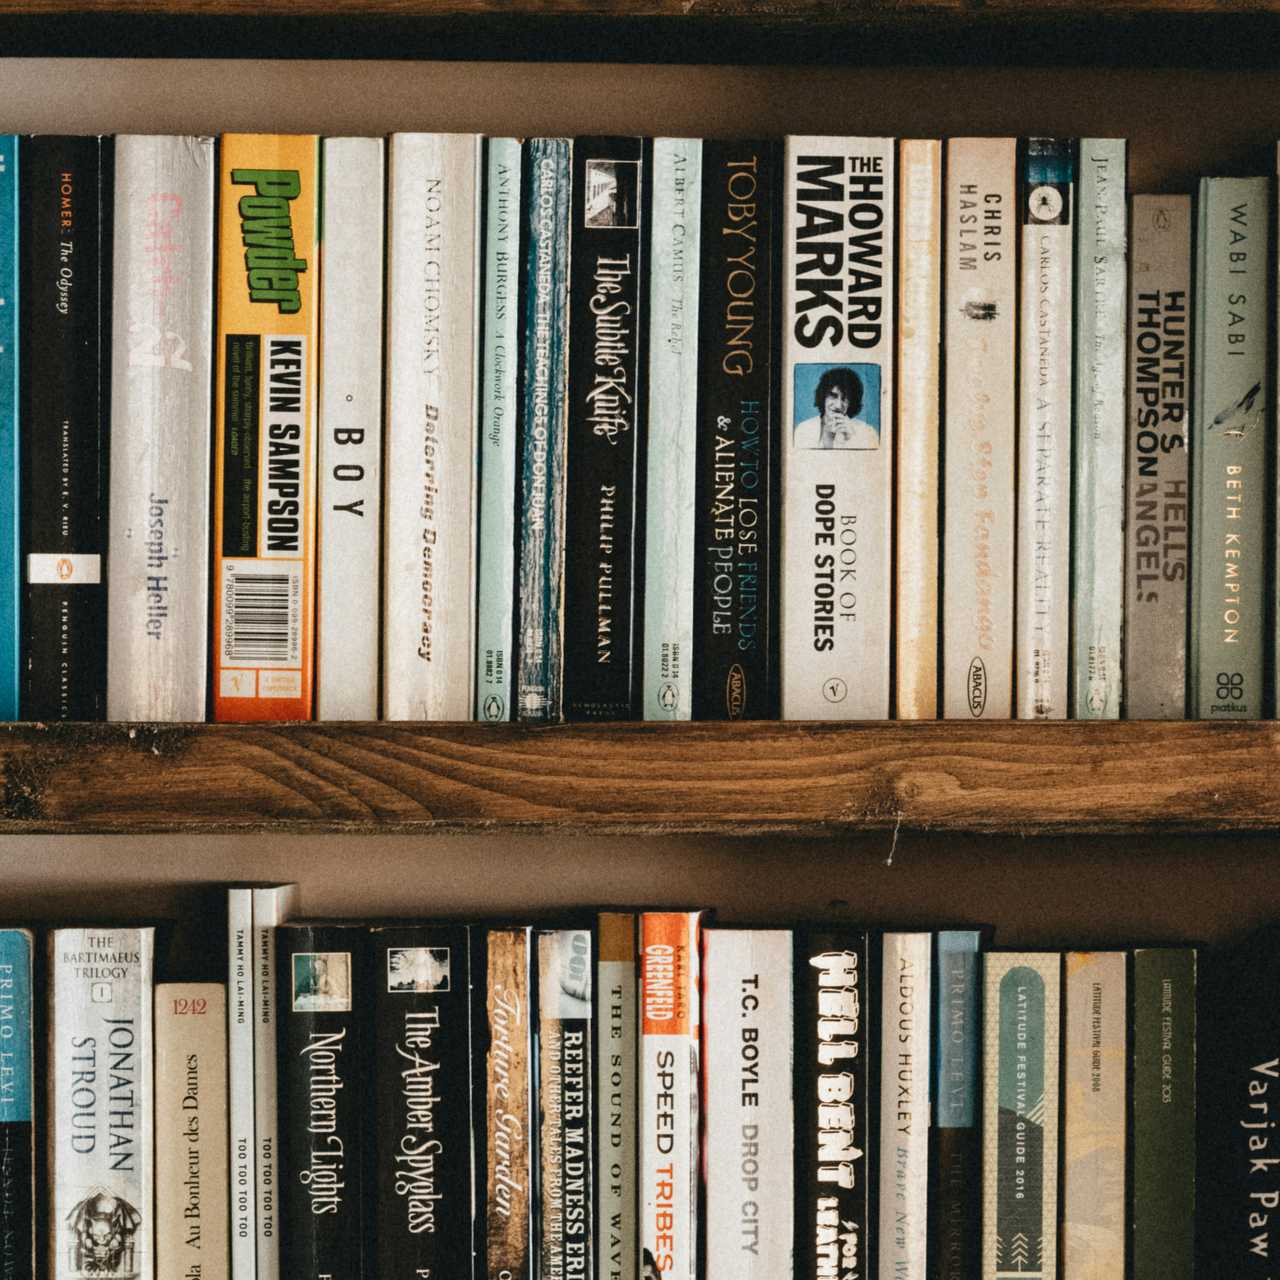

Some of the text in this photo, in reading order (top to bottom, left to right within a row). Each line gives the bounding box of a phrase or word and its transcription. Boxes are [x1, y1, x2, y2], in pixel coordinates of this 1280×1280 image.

[232, 169, 307, 314] Powder
[850, 157, 883, 172] THE
[55, 268, 72, 314] Odyssey
[59, 241, 72, 263] The
[795, 156, 844, 349] MARKS
[848, 176, 883, 349] HOWARD
[587, 254, 631, 445] The Subtle Knife
[267, 341, 300, 551] KEVIN SAMPSON
[597, 485, 616, 663] PHILIP PULLMAN
[814, 484, 835, 651] DOPE STORIES
[840, 515, 858, 621] BOOK OF
[71, 1037, 97, 1154] STROUD
[103, 1018, 134, 1172] JONATHAN
[564, 1032, 583, 1121] REEFER
[742, 975, 759, 1255] T.C. BOYLE DROP CITY
[1015, 986, 1026, 1199] LATITUDE FESTIVAL GUIDE 2016
[1241, 1058, 1280, 1258] Varjak Paw
[565, 1127, 584, 1234] MADNESS
[655, 1052, 673, 1271] SPEED TRIBES
